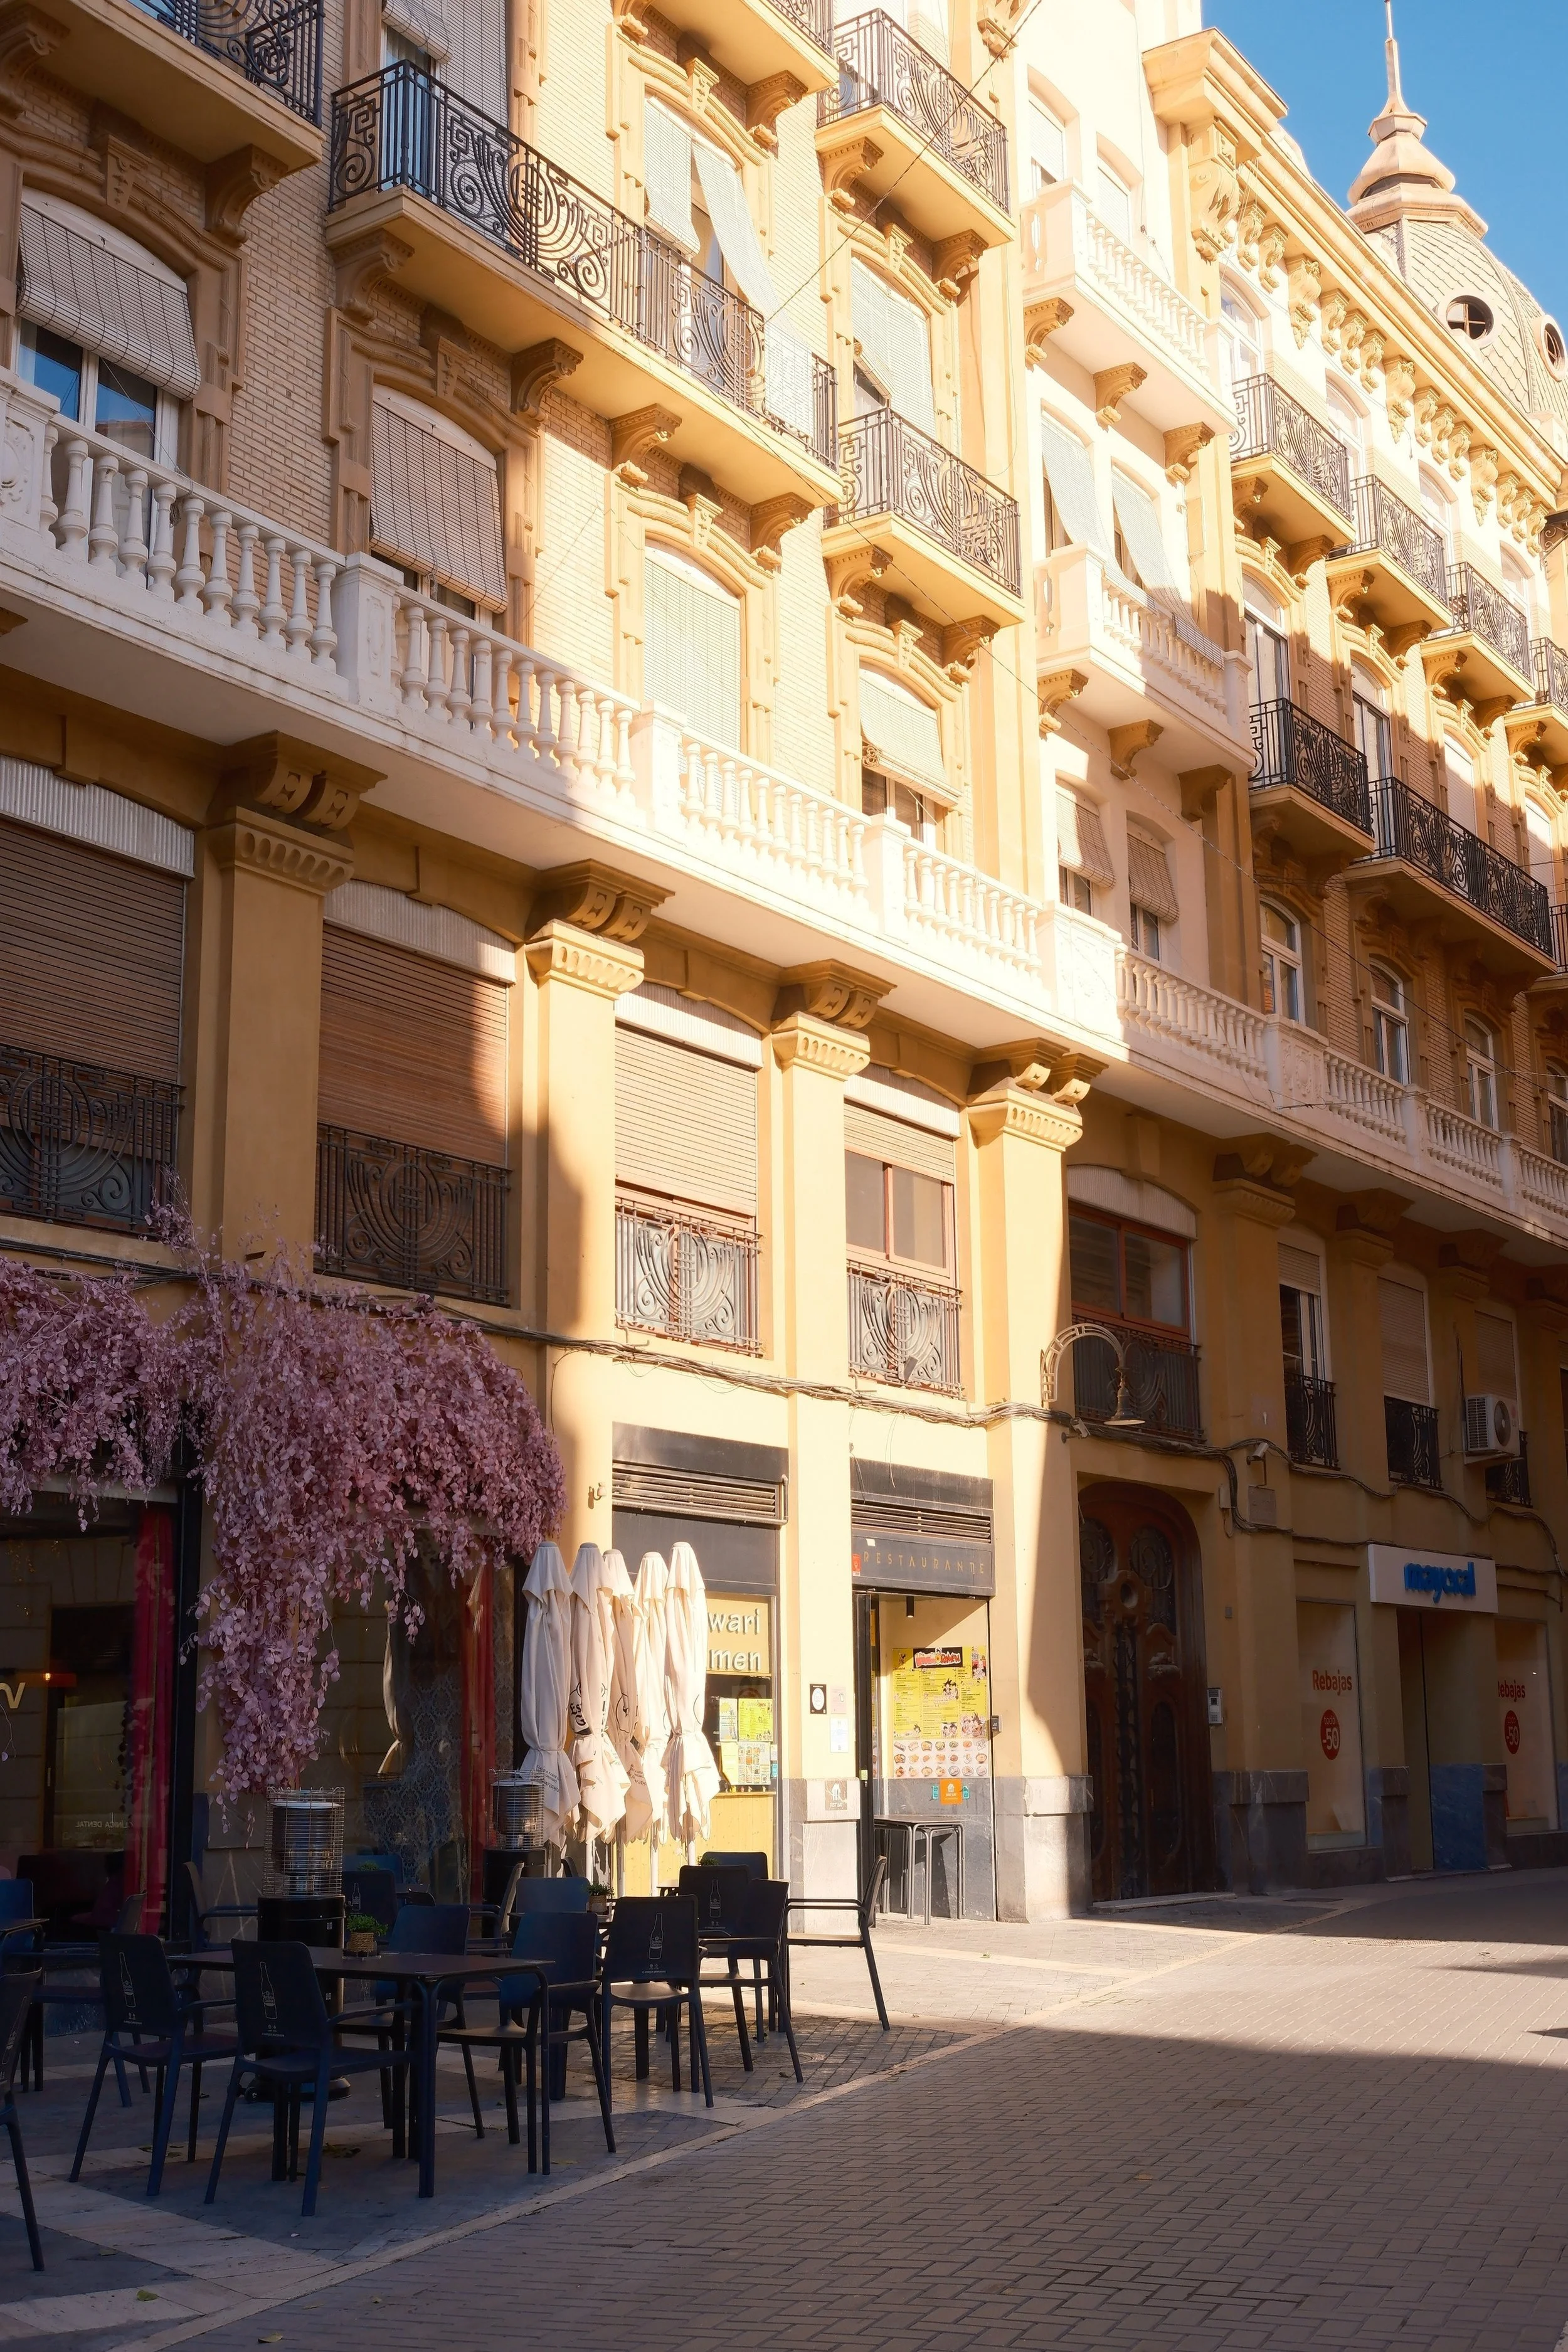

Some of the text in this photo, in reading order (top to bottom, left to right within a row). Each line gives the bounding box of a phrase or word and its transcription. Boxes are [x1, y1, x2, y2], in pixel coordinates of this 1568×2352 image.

[863, 1550, 984, 1574] RESTAURANTE
[1404, 1562, 1476, 1603] mayoral
[707, 1608, 760, 1635] wari
[709, 1649, 761, 1671] men
[1312, 1669, 1353, 1696] Rebajas
[1323, 1715, 1336, 1725] todo
